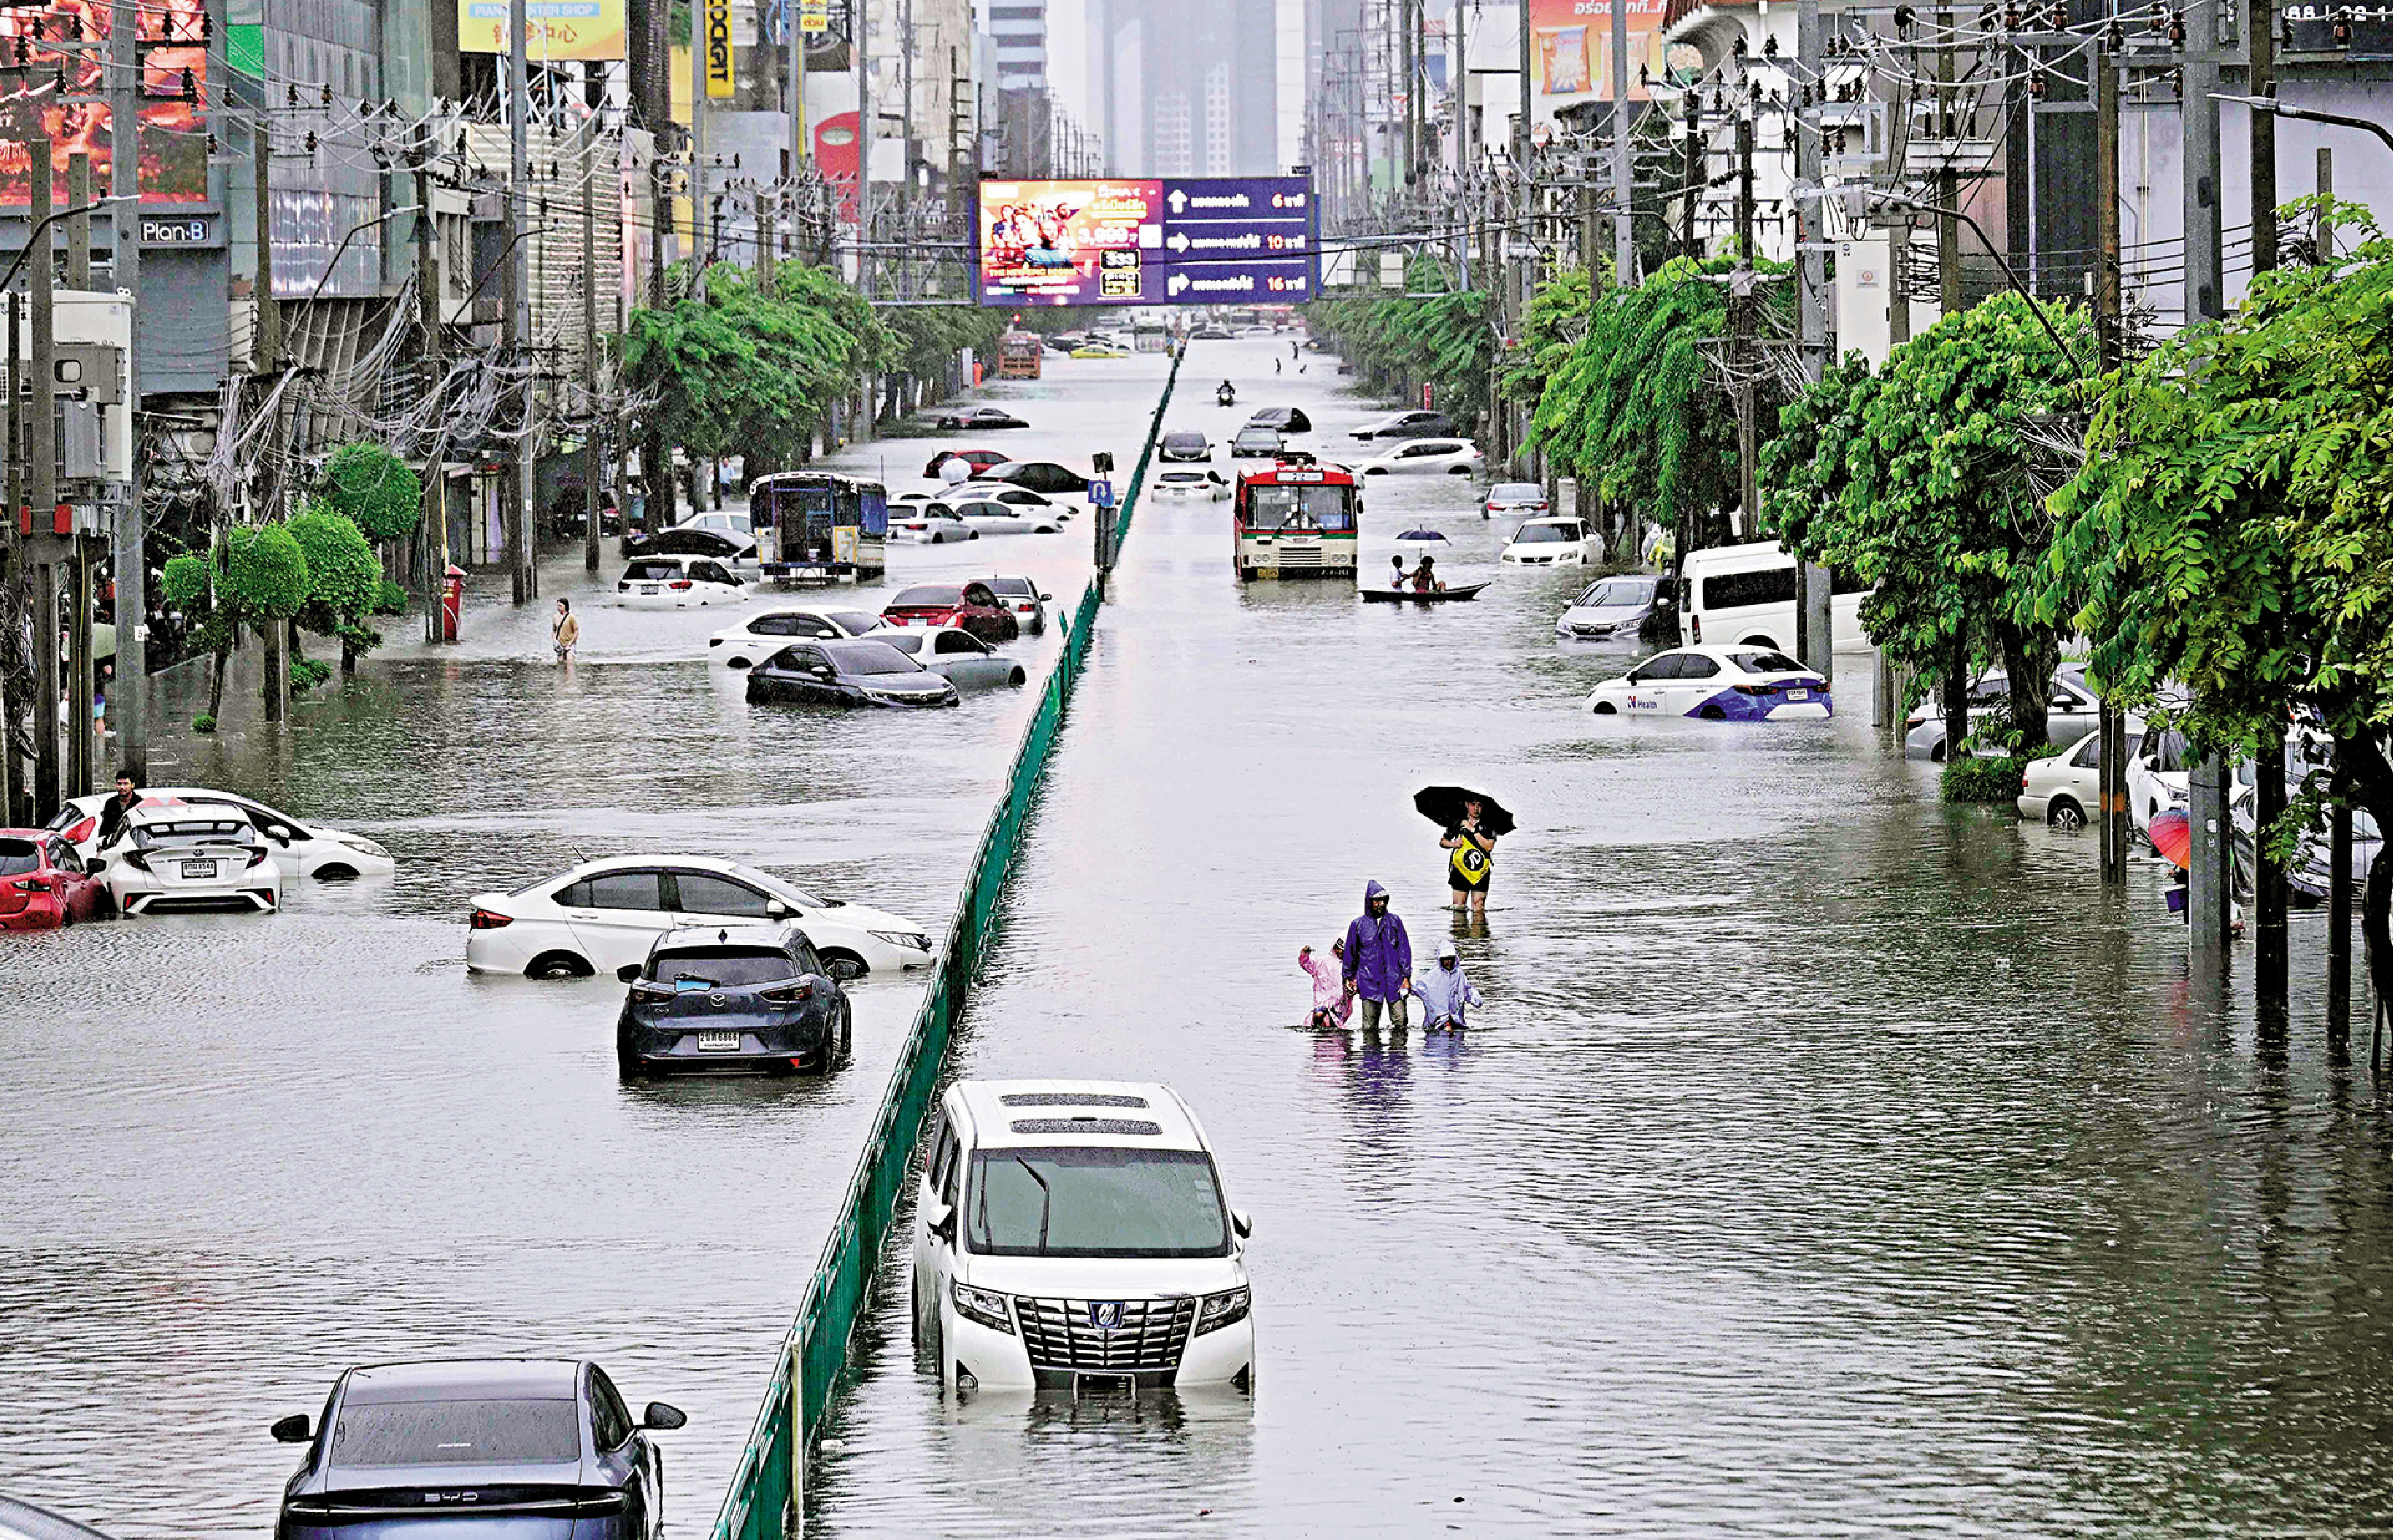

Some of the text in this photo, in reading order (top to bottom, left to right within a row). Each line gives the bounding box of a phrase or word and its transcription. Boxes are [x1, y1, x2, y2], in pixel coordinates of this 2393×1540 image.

[561, 5, 593, 15] SHOP
[1272, 192, 1284, 208] 6
[1267, 234, 1284, 250] 10
[1268, 275, 1285, 292] 16
[424, 1492, 479, 1503] BYD
